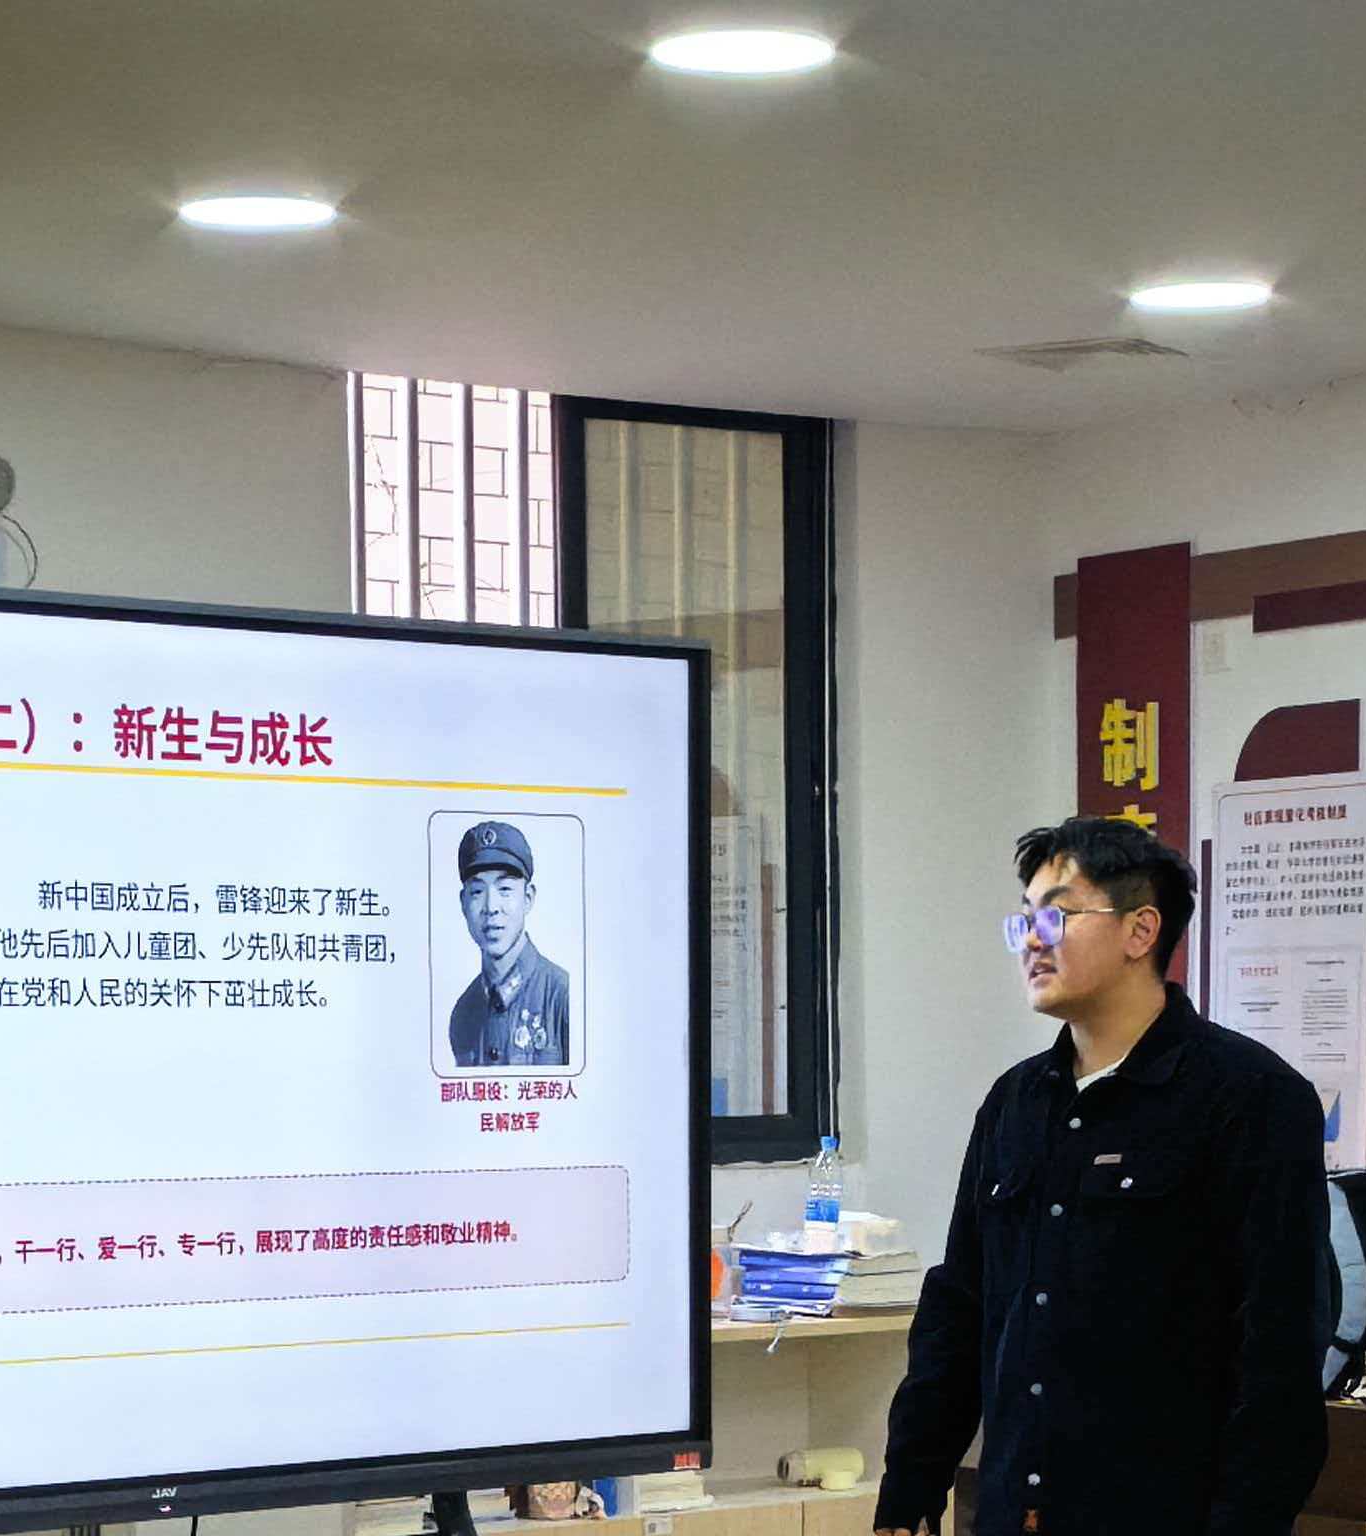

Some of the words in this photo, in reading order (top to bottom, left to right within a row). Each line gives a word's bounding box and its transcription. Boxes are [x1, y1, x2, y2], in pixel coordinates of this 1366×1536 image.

[1099, 698, 1160, 834] 制
[37, 880, 391, 918] 新中国成立后，雷锋迎来了新生。
[480, 1111, 541, 1133] 民解放军
